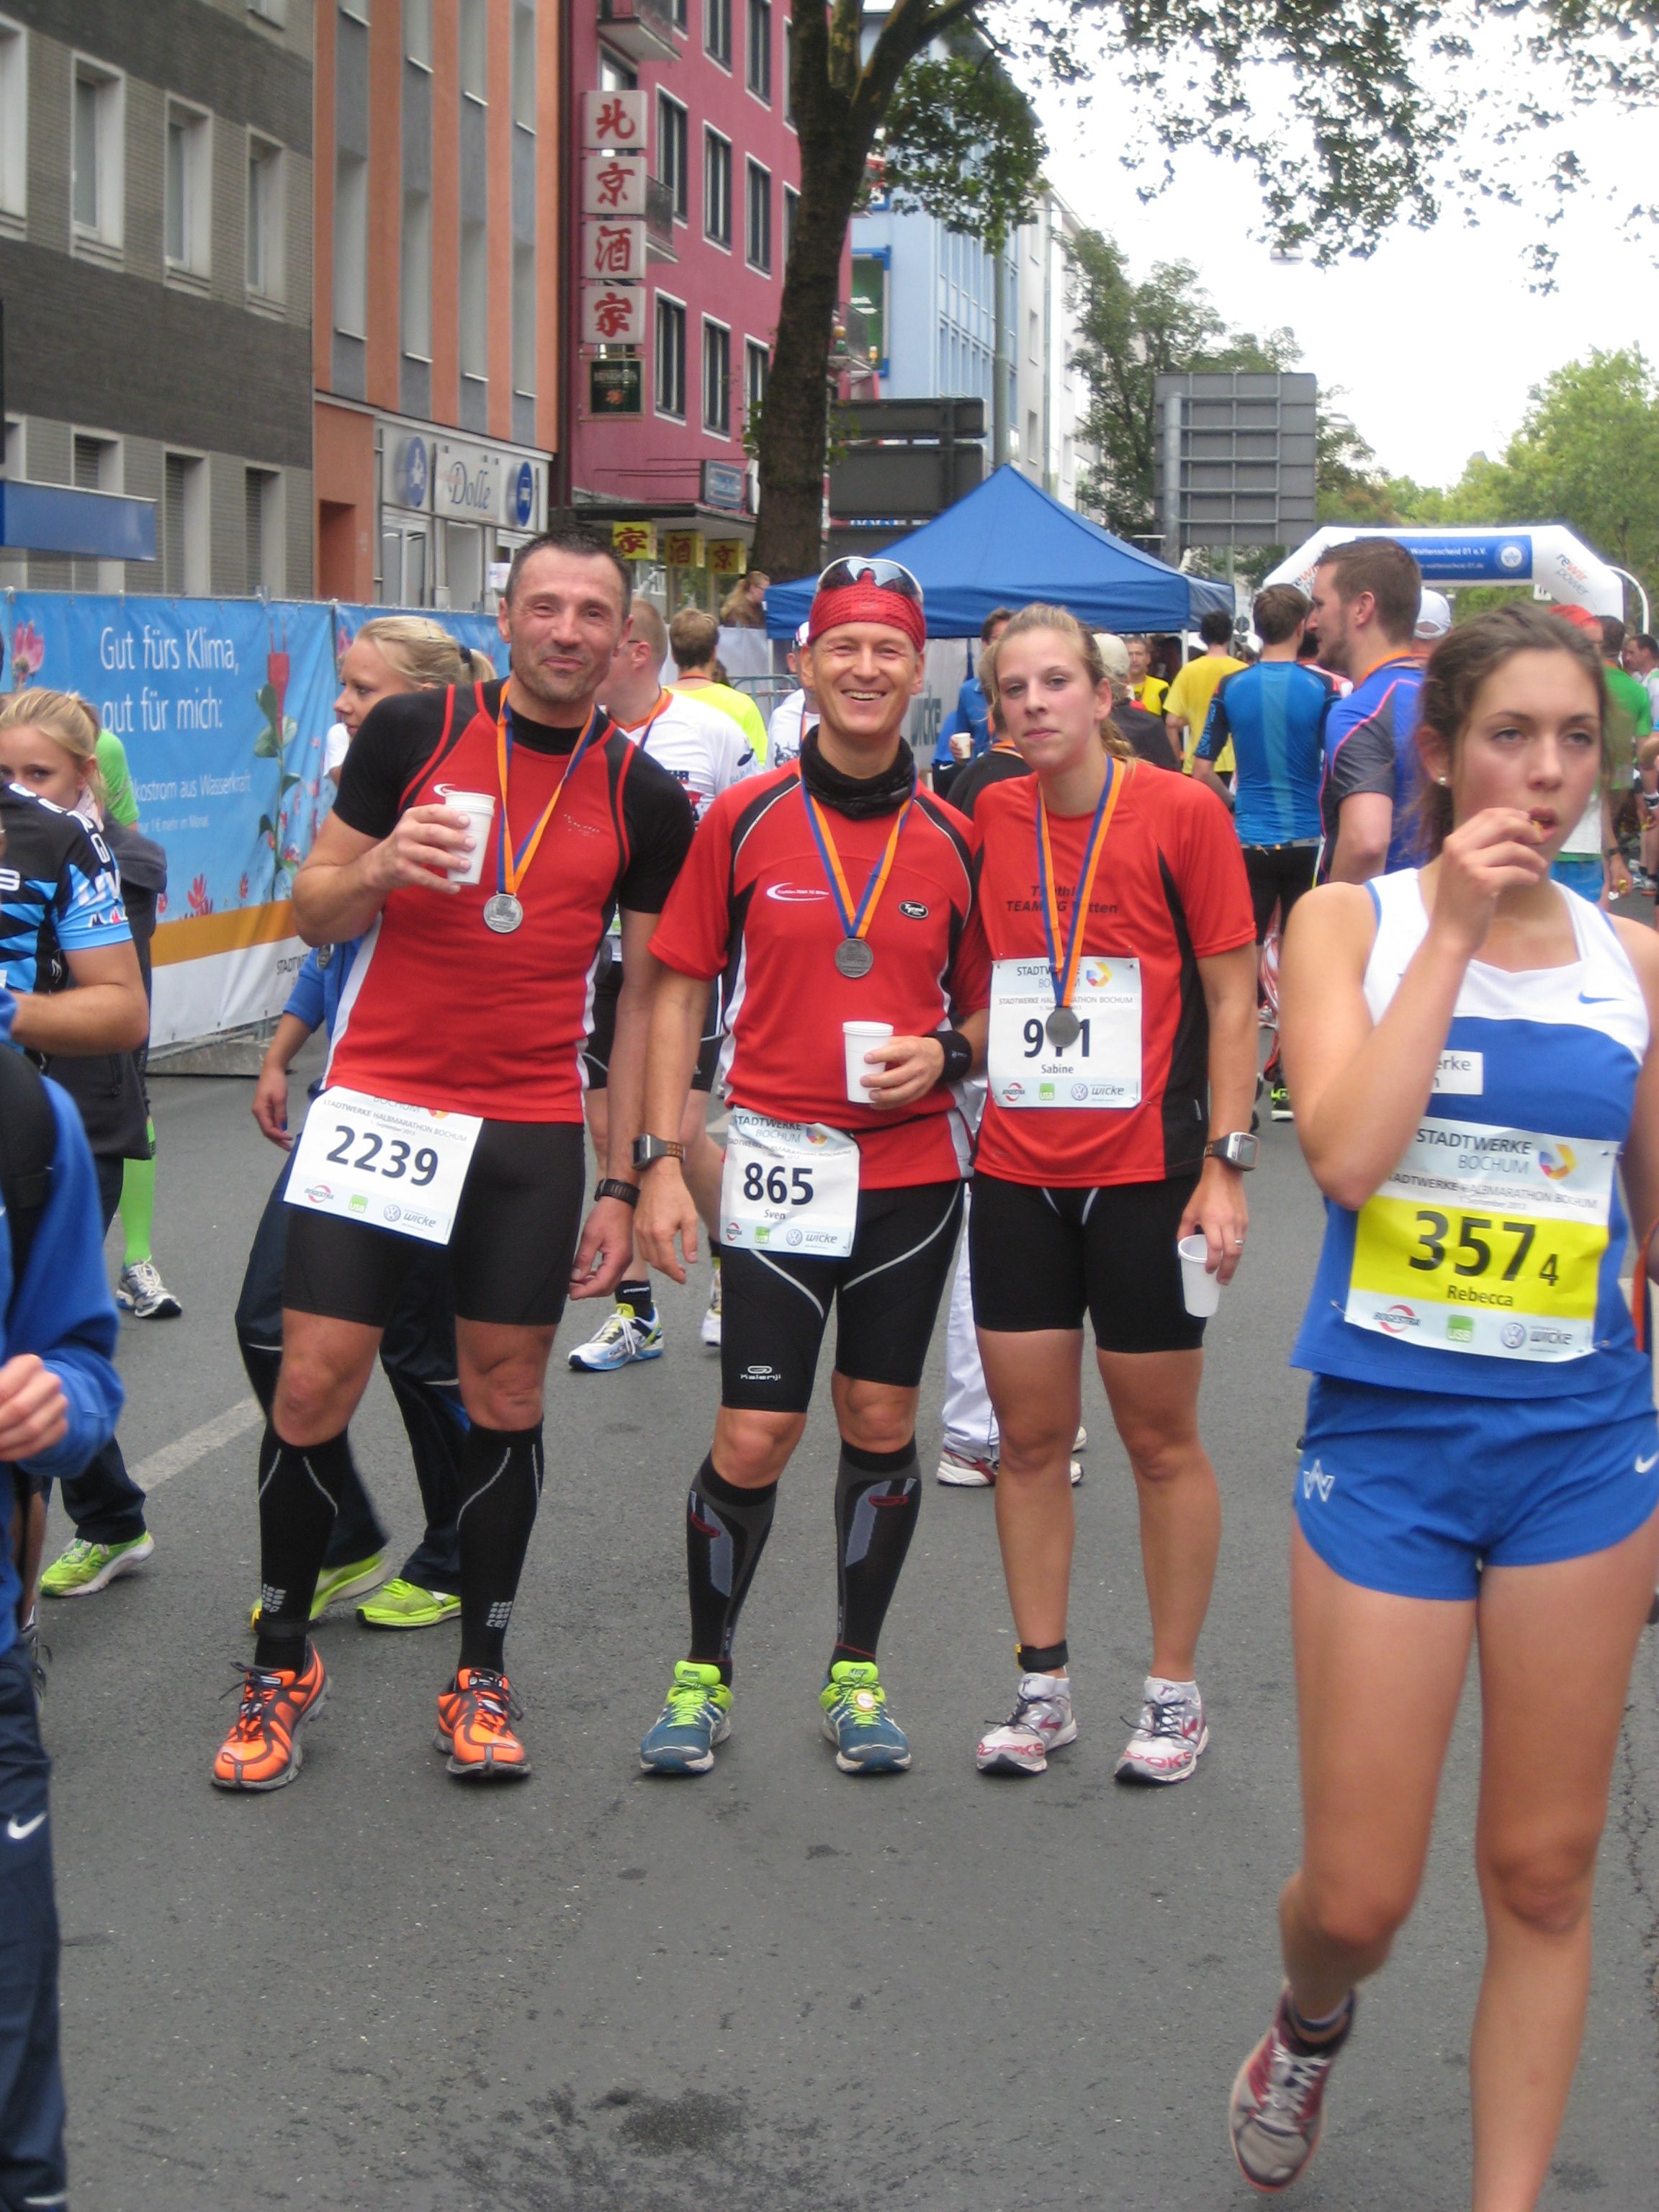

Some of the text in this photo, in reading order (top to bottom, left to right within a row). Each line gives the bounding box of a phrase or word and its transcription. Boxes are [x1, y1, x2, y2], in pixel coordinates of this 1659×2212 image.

[595, 98, 635, 338] 北京酒家
[614, 527, 647, 554] 家
[100, 624, 240, 675] Gut fürs Klima,
[102, 693, 134, 733] gut
[140, 685, 169, 732] für
[132, 768, 251, 801] kostrom aus Wasserkraft
[1040, 1064, 1074, 1074] Sabine
[322, 1099, 468, 1143] STADTWERKE HALBMARATHON BOCHUM
[755, 1128, 801, 1143] BOCHUM
[1416, 1128, 1532, 1155] STADTWERKE
[325, 1125, 439, 1187] 2239
[1457, 1154, 1530, 1174] BOCHUM
[742, 1161, 814, 1206] 865
[403, 1211, 436, 1228] wicke
[763, 1208, 786, 1220] Sven
[805, 1233, 838, 1244] wicke
[1447, 1283, 1514, 1307] Rebecca
